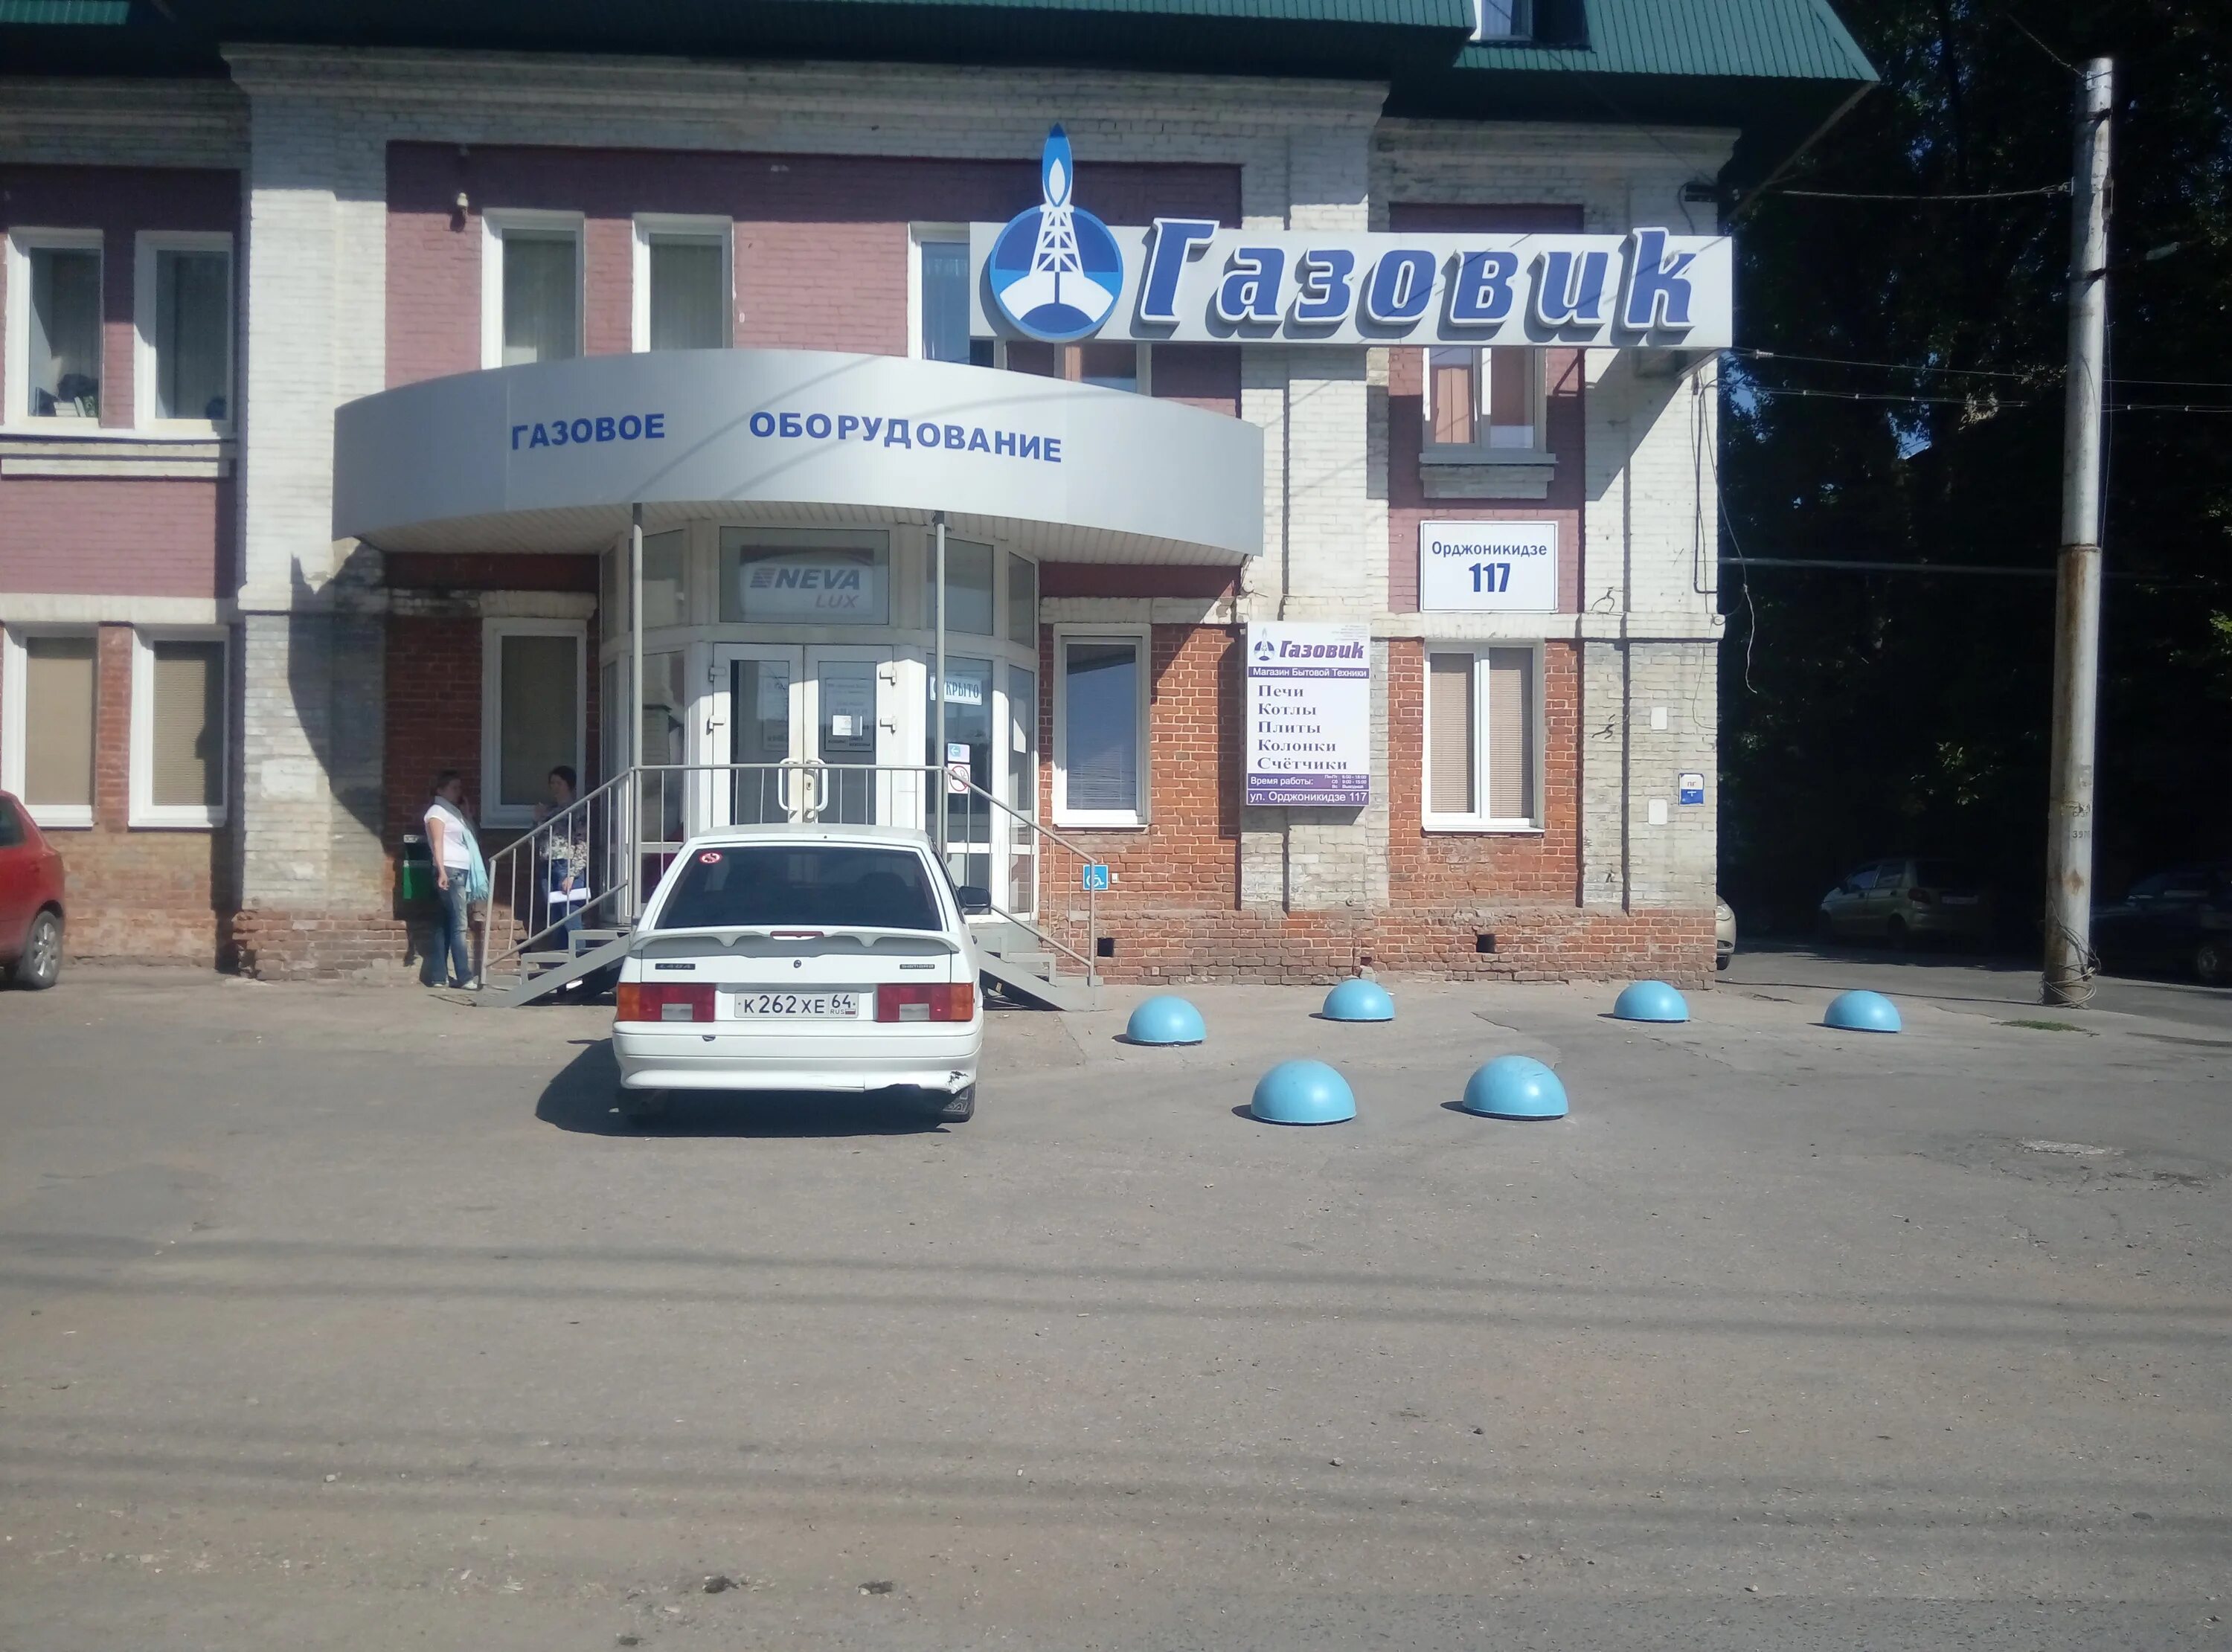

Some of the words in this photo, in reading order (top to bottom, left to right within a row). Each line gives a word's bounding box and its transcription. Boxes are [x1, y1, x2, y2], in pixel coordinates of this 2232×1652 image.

[1139, 217, 1697, 328] Газовик
[512, 414, 665, 450] ГАЗОВОЕ
[749, 411, 1062, 463] ОБОРУДОВАНИЕ
[1431, 541, 1548, 558] Орджоникидзе
[775, 568, 860, 590] NEVA
[1469, 563, 1511, 592] 117
[815, 594, 859, 608] LUX
[1279, 640, 1364, 659] Газовик
[1253, 667, 1290, 677] Магазин
[1292, 668, 1330, 677] Бытовой
[1333, 669, 1367, 678] Техники
[933, 680, 980, 698] КРЫТО
[1258, 684, 1303, 697] Печи
[1258, 703, 1316, 716] Котлы
[1258, 721, 1321, 733] Плиты
[1258, 739, 1336, 752] Колонки
[1257, 756, 1347, 770] Счётчики
[1250, 777, 1277, 785] Время
[1280, 777, 1314, 786] работы:
[1250, 794, 1265, 803] ул.
[1269, 791, 1346, 802] Орджоникидзе
[1350, 793, 1367, 802] 117
[832, 994, 851, 1009] 64
